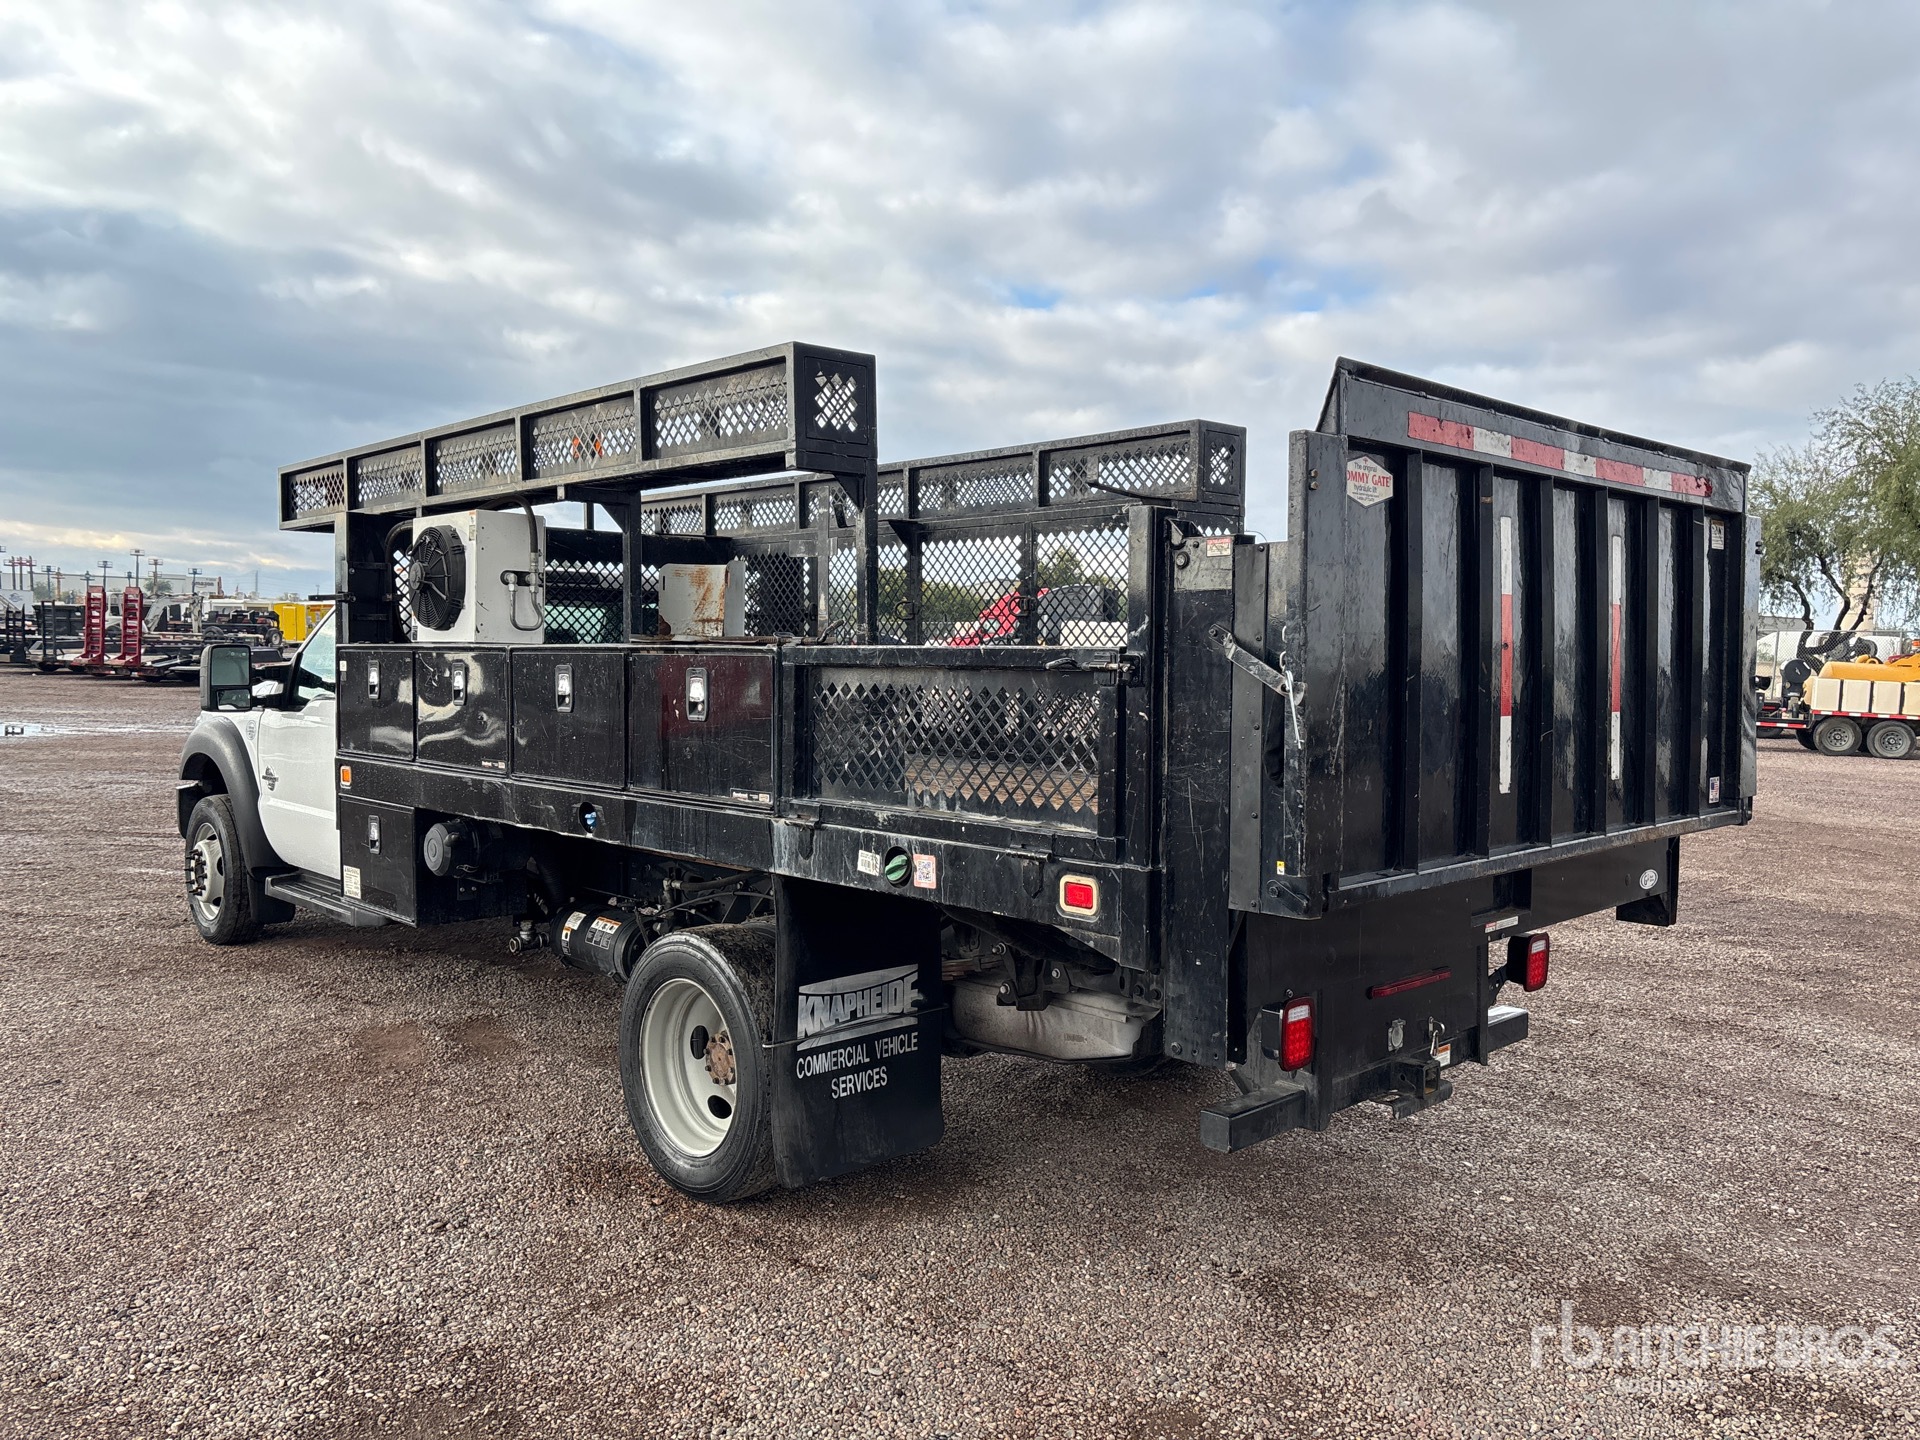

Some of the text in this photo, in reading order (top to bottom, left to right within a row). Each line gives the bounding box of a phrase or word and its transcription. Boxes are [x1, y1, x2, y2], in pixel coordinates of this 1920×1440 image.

[797, 971, 919, 1039] KNAPHEIDE
[796, 1032, 918, 1079] COMMERCIAL VEHICLE
[831, 1066, 888, 1099] SERVICES
